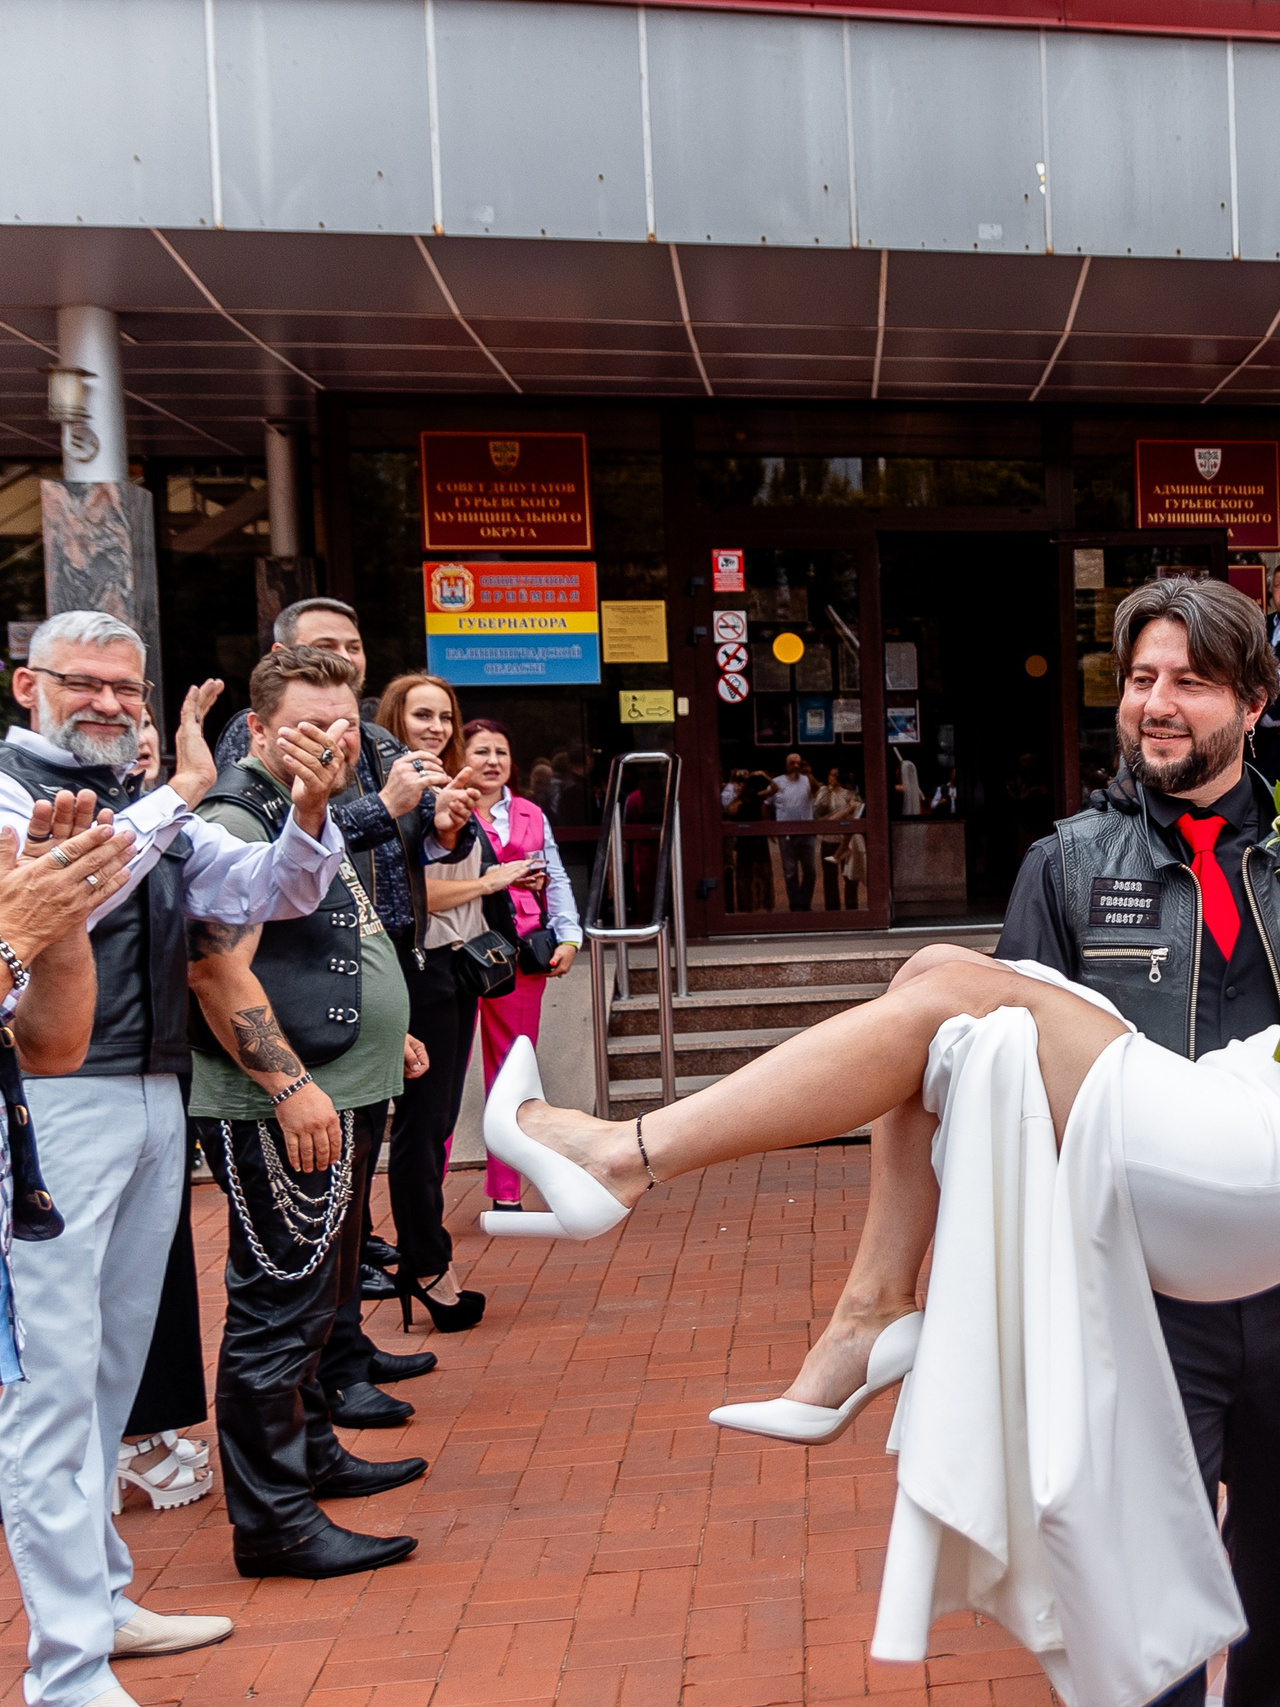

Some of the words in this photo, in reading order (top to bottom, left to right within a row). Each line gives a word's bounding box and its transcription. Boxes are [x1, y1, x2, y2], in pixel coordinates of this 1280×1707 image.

[436, 482, 484, 493] СОВЕТ
[489, 482, 576, 494] ДЕПУТАТОВ
[1153, 484, 1264, 496] АДМИНИСТРАЦИЯ
[454, 496, 560, 508] ГУРЬЕВСКОГО
[1165, 499, 1254, 510] ГУРЬЕВСКОГО
[434, 511, 582, 524] МУНИЦИПАЛЬНОГО
[1147, 512, 1272, 524] МУНИЦИПАЛЬНОГО
[480, 527, 537, 538] ОКРУГА
[480, 575, 579, 588] ОБЩЕСТВЕННАЯ
[458, 617, 567, 629] ГУБЕРНАТОРА
[445, 644, 582, 660] КАЛИНИНГРАДСКОЙ
[484, 663, 546, 675] ОБЛАСТИ
